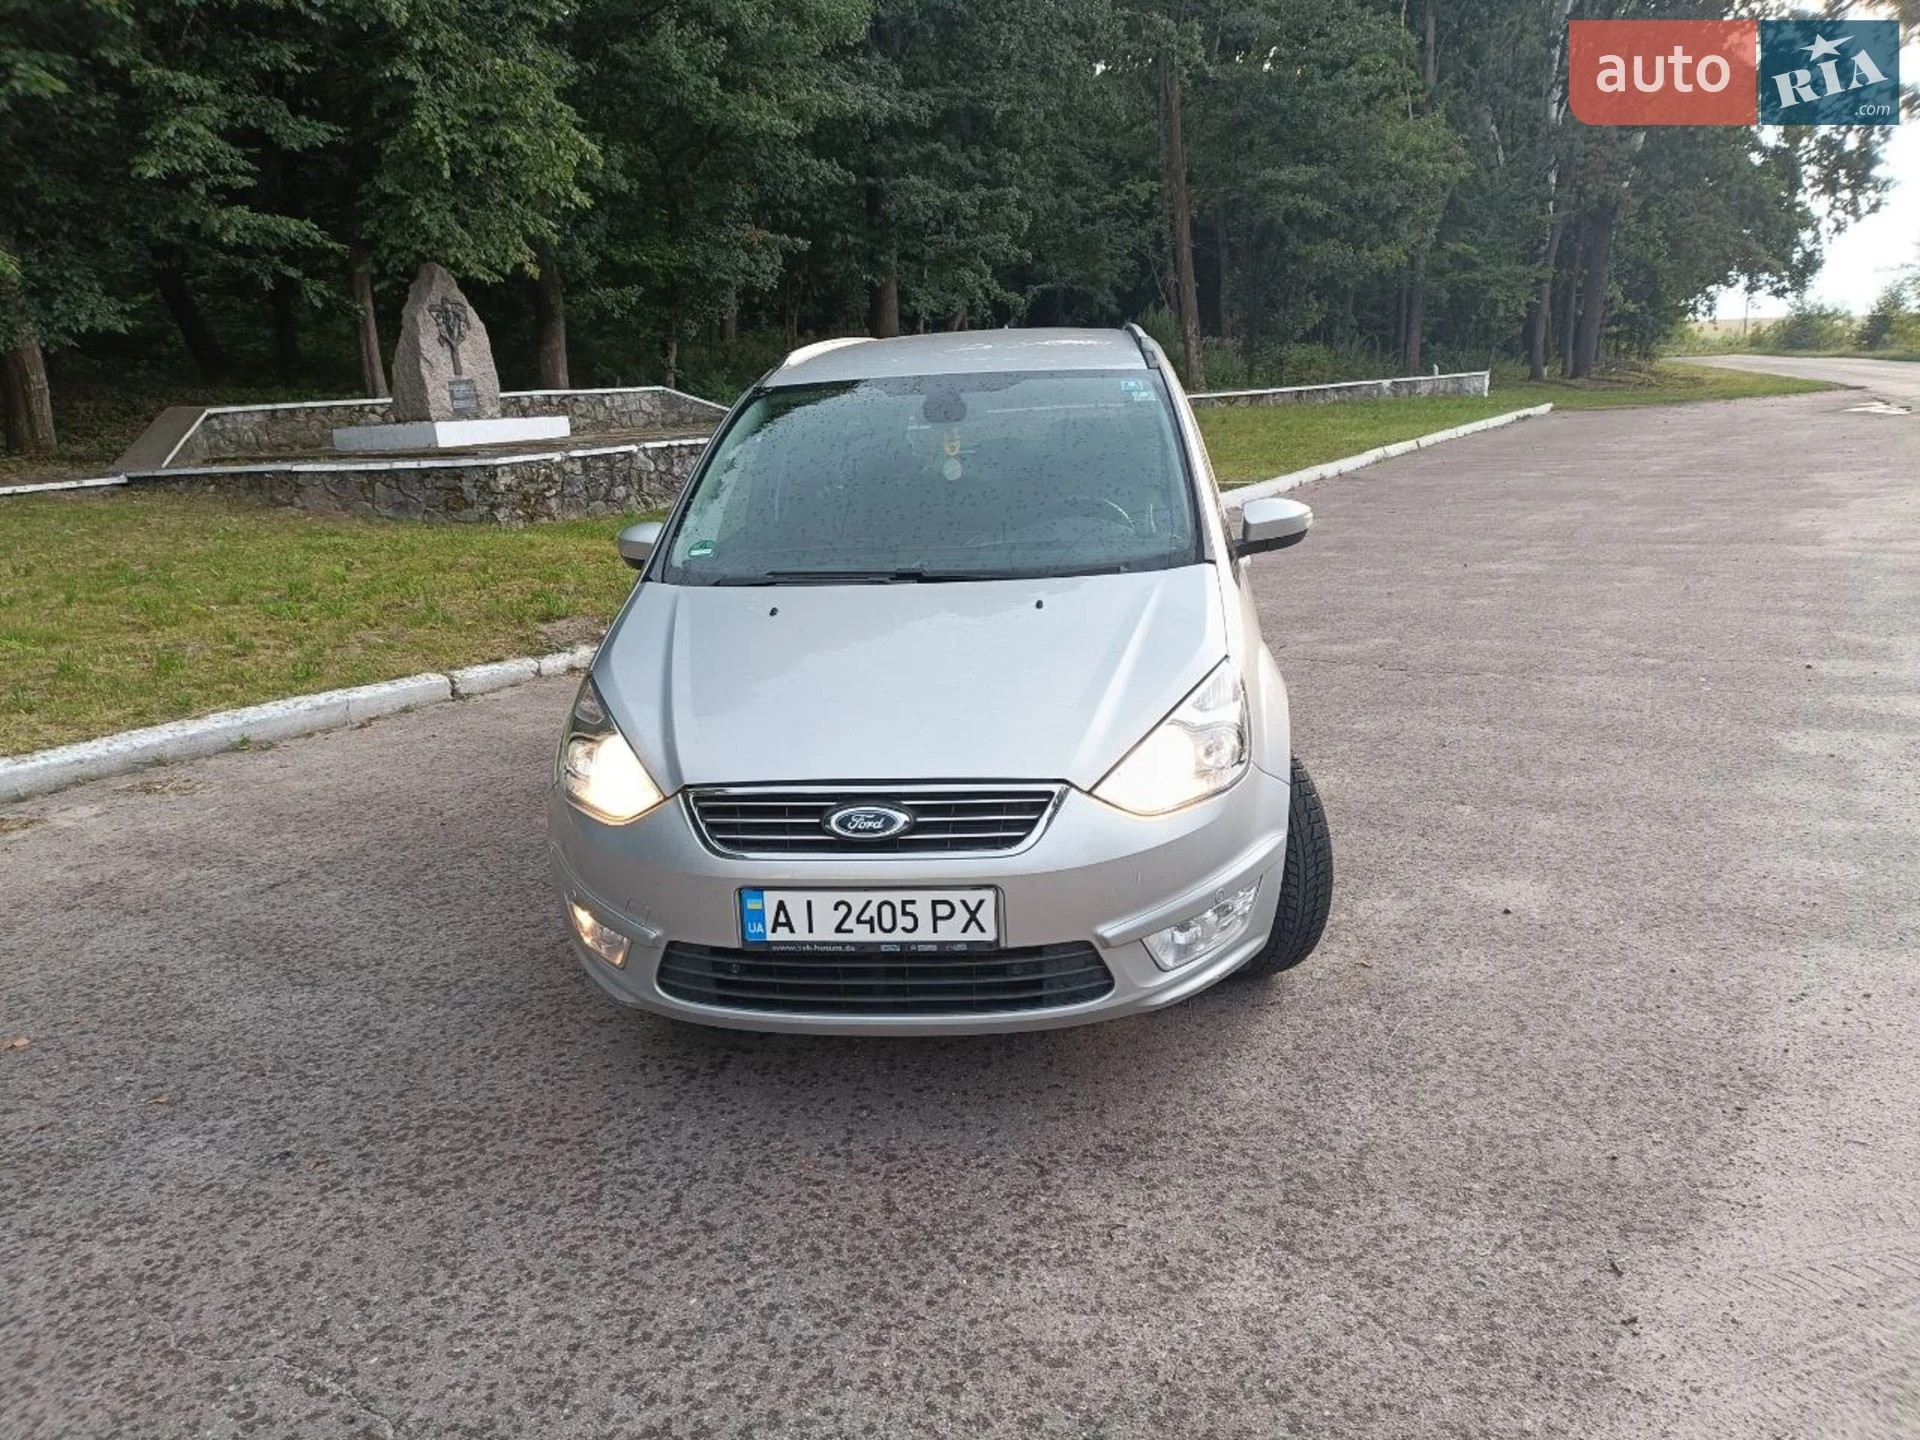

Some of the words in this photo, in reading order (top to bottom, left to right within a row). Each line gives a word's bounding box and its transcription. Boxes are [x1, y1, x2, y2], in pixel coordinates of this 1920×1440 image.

[847, 814, 885, 829] Ford
[770, 900, 814, 934] AI
[833, 900, 919, 934] 2405
[931, 899, 986, 934] PX
[748, 922, 764, 933] UA
